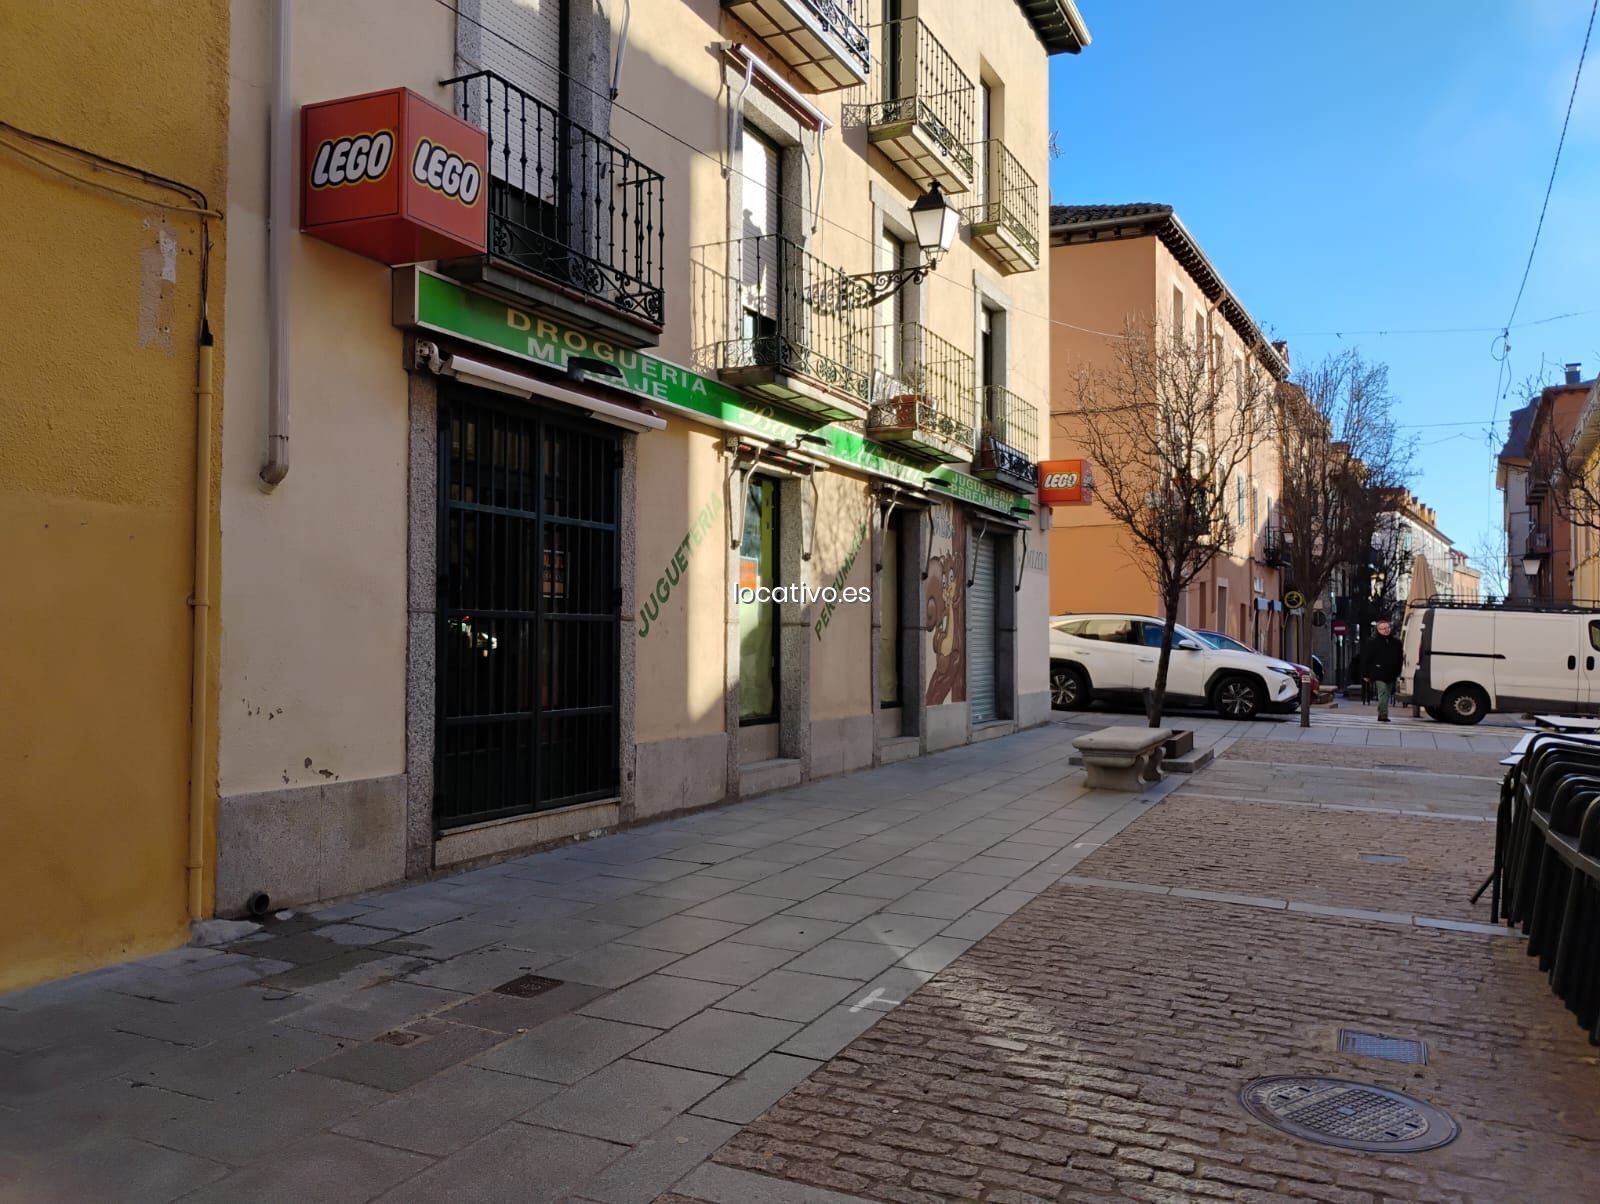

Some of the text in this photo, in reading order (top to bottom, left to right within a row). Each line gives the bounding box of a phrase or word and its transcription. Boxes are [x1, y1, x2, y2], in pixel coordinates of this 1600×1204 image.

[312, 131, 393, 188] LEGO
[412, 138, 481, 206] LEGO
[507, 308, 707, 396] DROGUERIA
[527, 337, 669, 400] MEAJE
[952, 473, 1014, 504] JUGUETERIA
[1044, 473, 1078, 488] LEGO
[638, 491, 723, 639] JUGUETERIA
